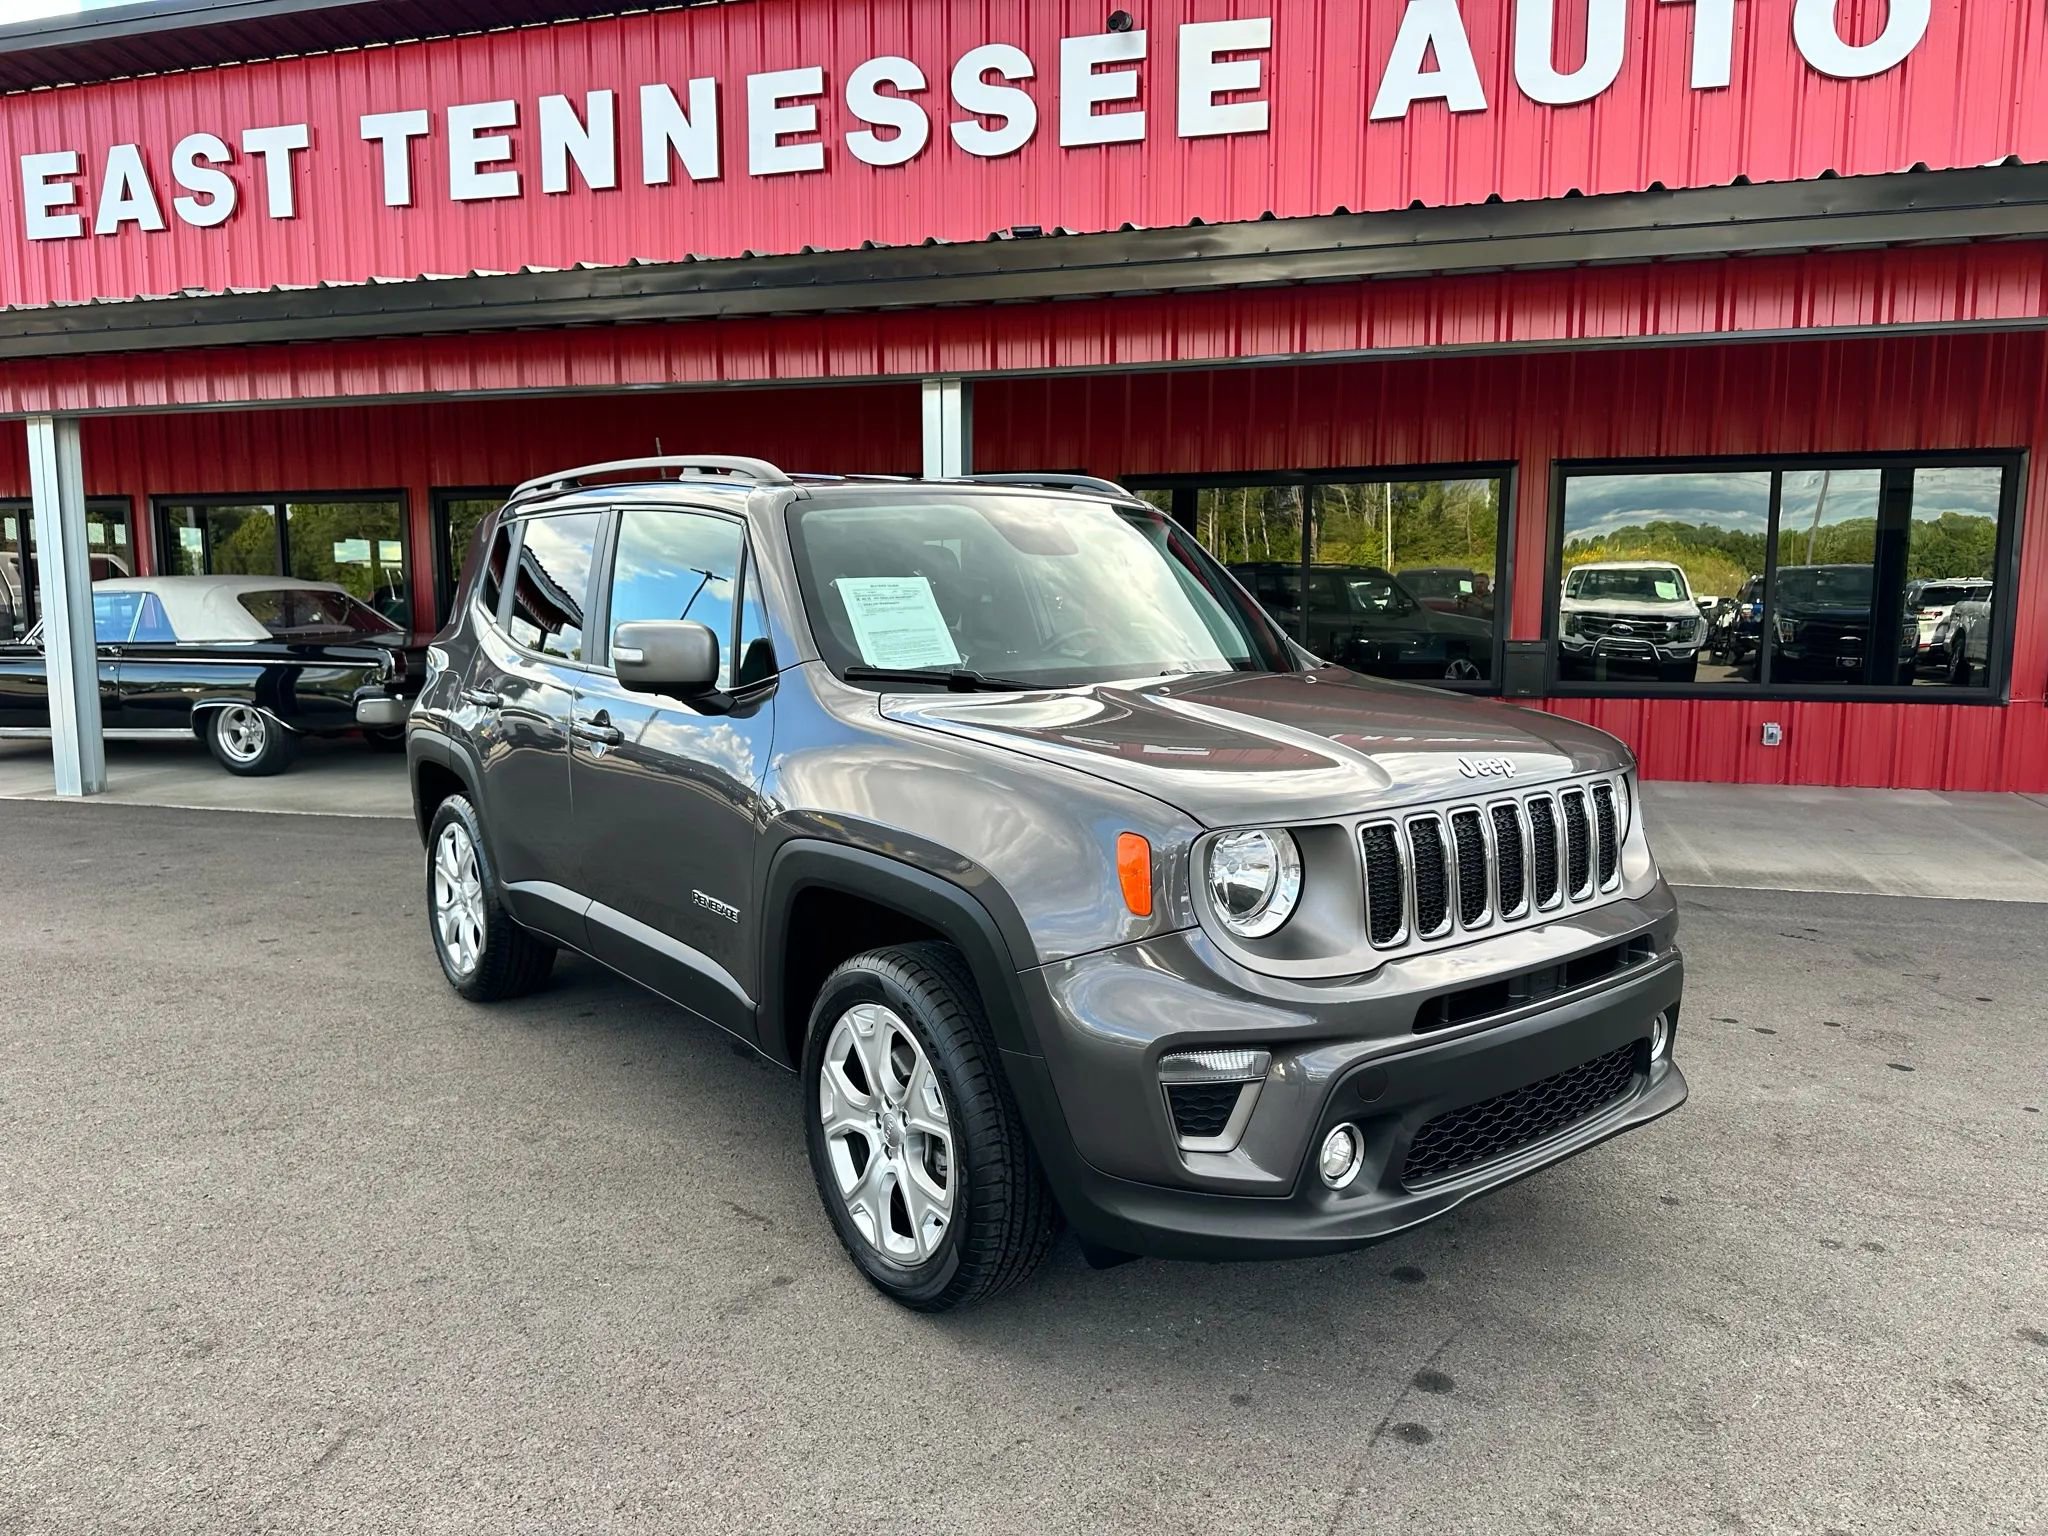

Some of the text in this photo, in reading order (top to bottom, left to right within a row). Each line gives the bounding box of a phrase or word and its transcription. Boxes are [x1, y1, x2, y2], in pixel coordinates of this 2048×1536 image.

[20, 0, 1932, 241] EAST TENNESSEE AUTO
[1458, 757, 1517, 779] Jeep
[692, 889, 741, 923] RENEGADE
